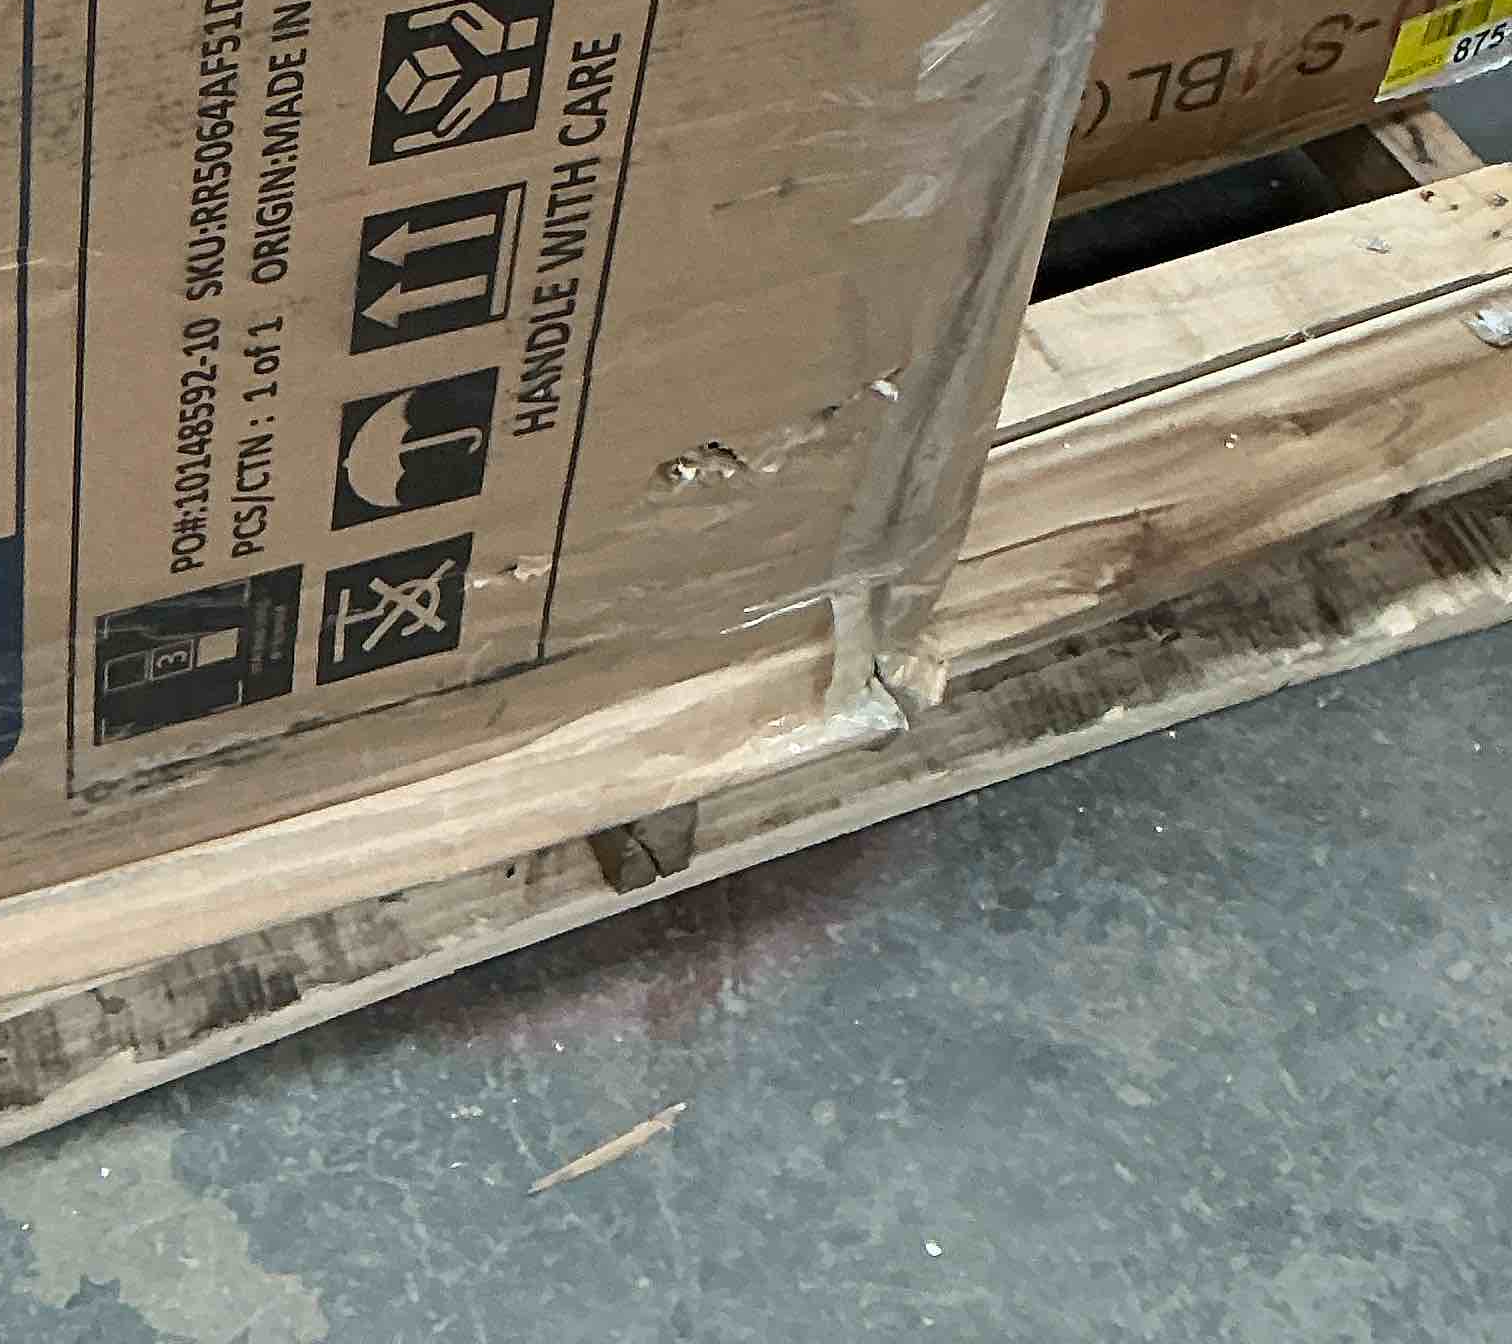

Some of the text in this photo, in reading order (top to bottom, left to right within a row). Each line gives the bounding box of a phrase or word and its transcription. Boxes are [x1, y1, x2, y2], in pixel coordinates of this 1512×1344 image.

[271, 0, 313, 44] IN
[250, 47, 308, 286] ORIGIN:MADE
[512, 32, 622, 439] HANDLE WITH CARE
[247, 314, 284, 338] 1
[243, 344, 281, 375] of
[243, 380, 278, 403] 1
[170, 316, 221, 575] PO#:10148592-10
